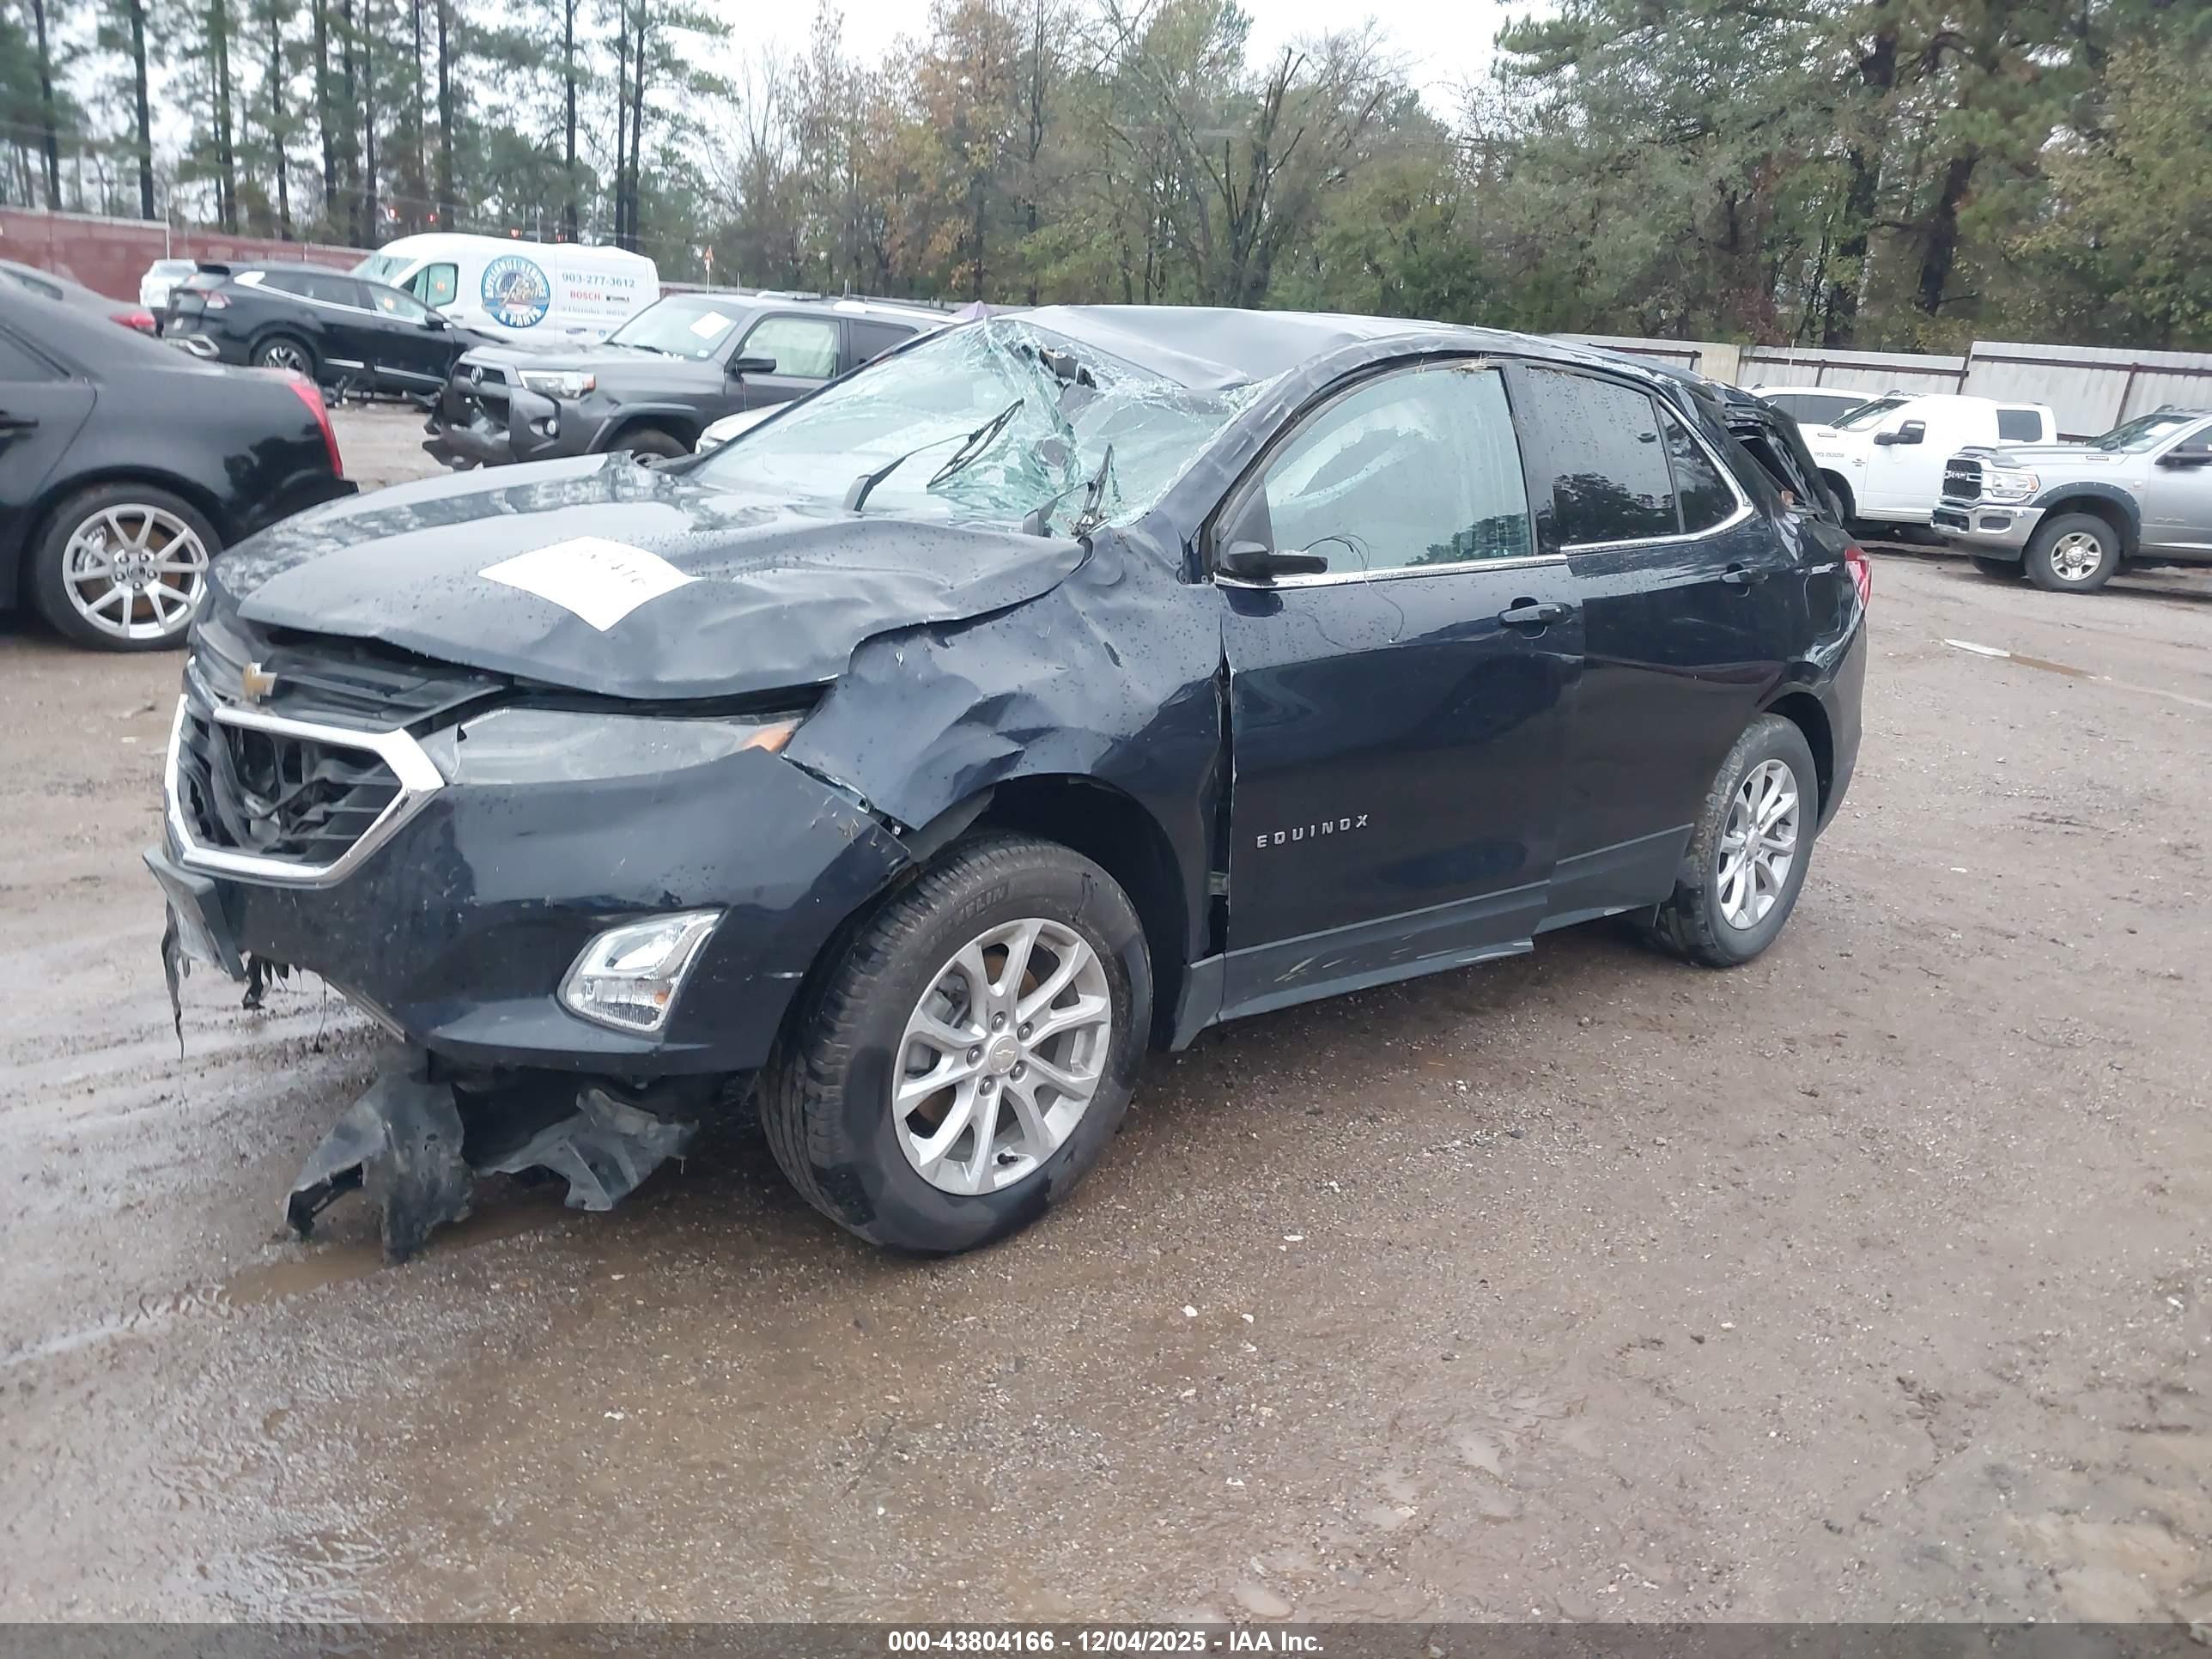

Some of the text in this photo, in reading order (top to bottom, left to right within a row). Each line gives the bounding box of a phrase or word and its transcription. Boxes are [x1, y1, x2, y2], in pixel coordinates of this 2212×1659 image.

[562, 272, 635, 288] 903-277-3612
[570, 290, 600, 301] BOSCH
[1256, 814, 1368, 848] EQUINOX
